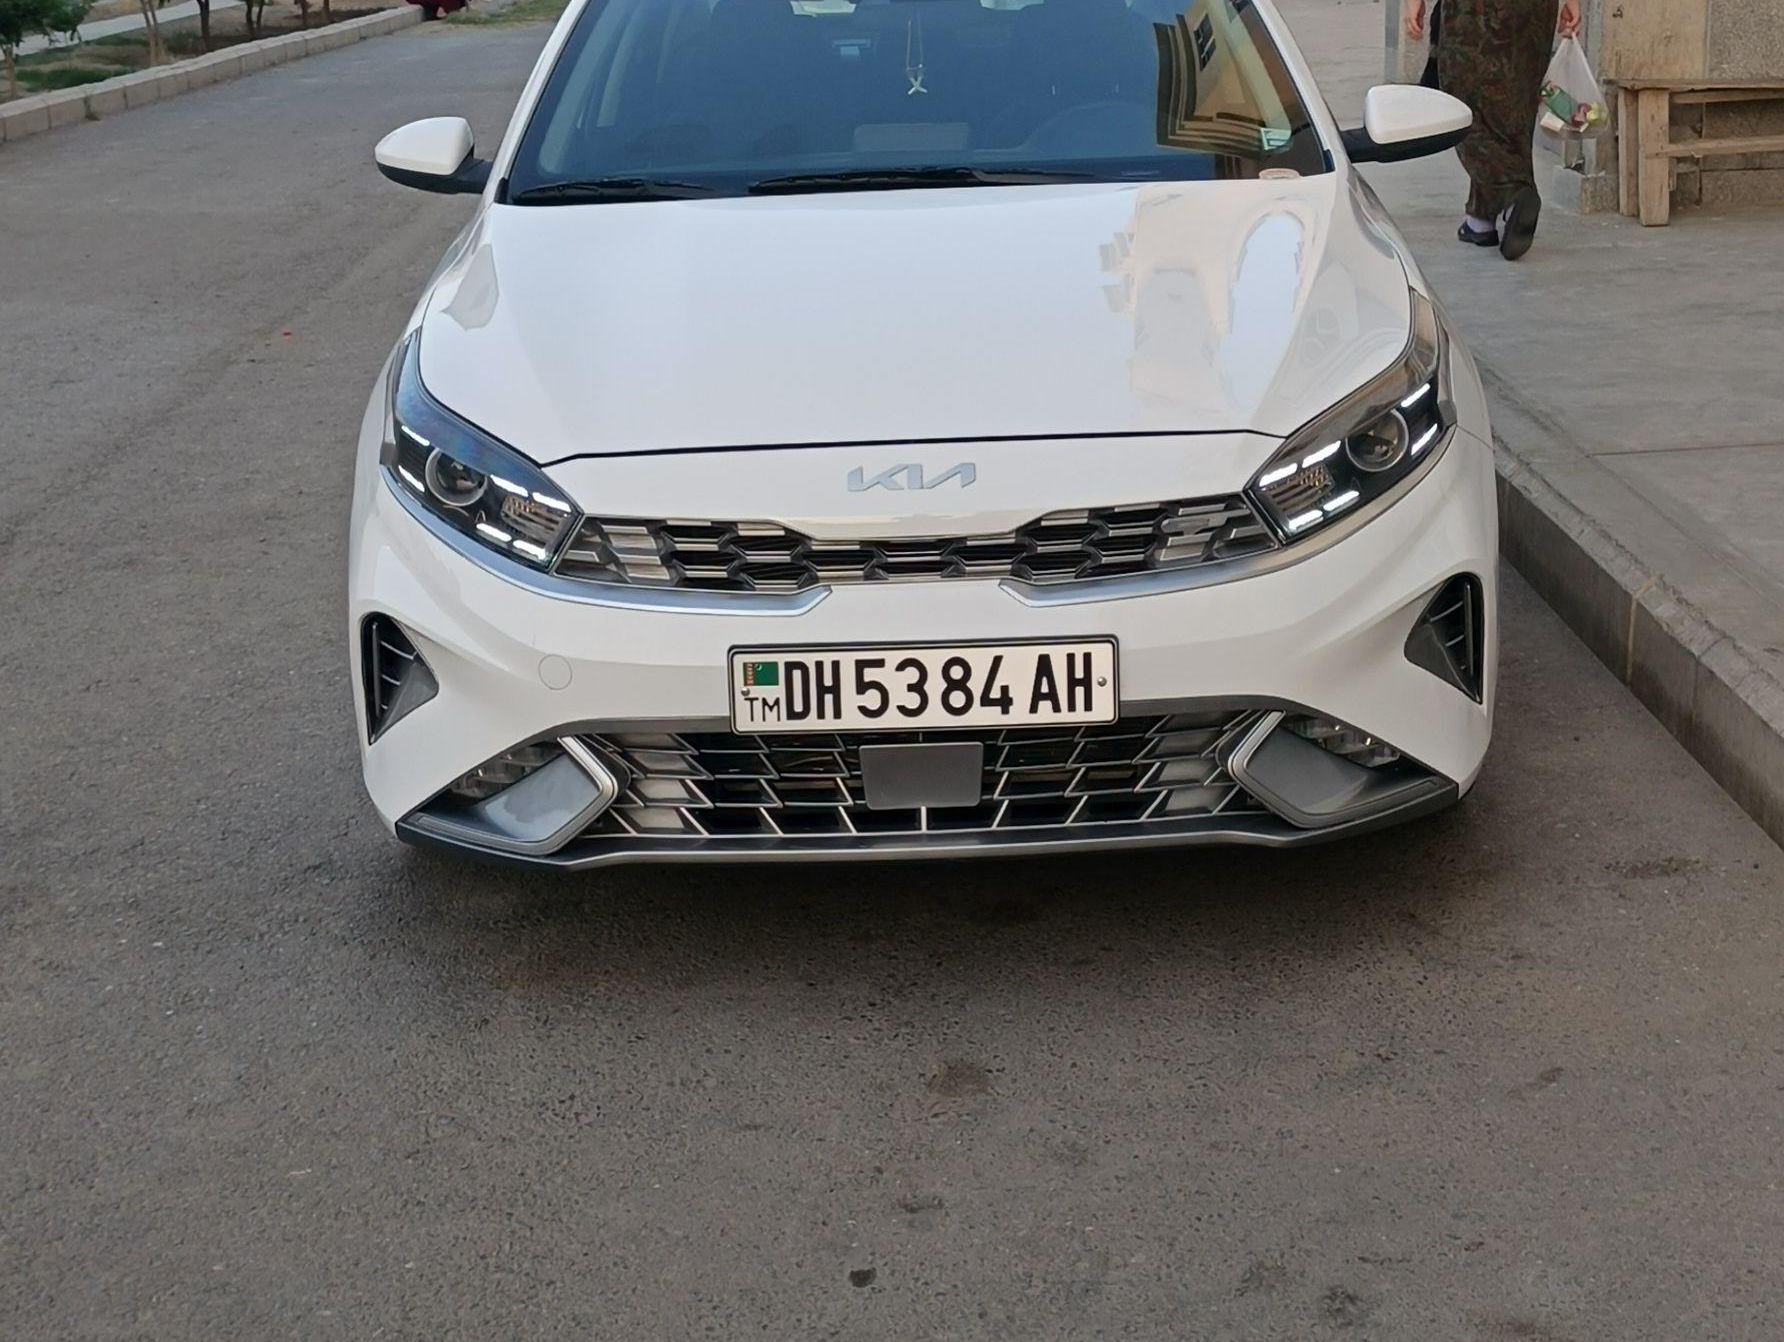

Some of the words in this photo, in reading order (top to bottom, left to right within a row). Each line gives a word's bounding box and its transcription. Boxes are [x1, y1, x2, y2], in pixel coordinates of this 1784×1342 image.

[744, 696, 780, 722] TM
[784, 660, 842, 720] DH
[855, 655, 1013, 718] 5384
[1029, 652, 1093, 714] AH
